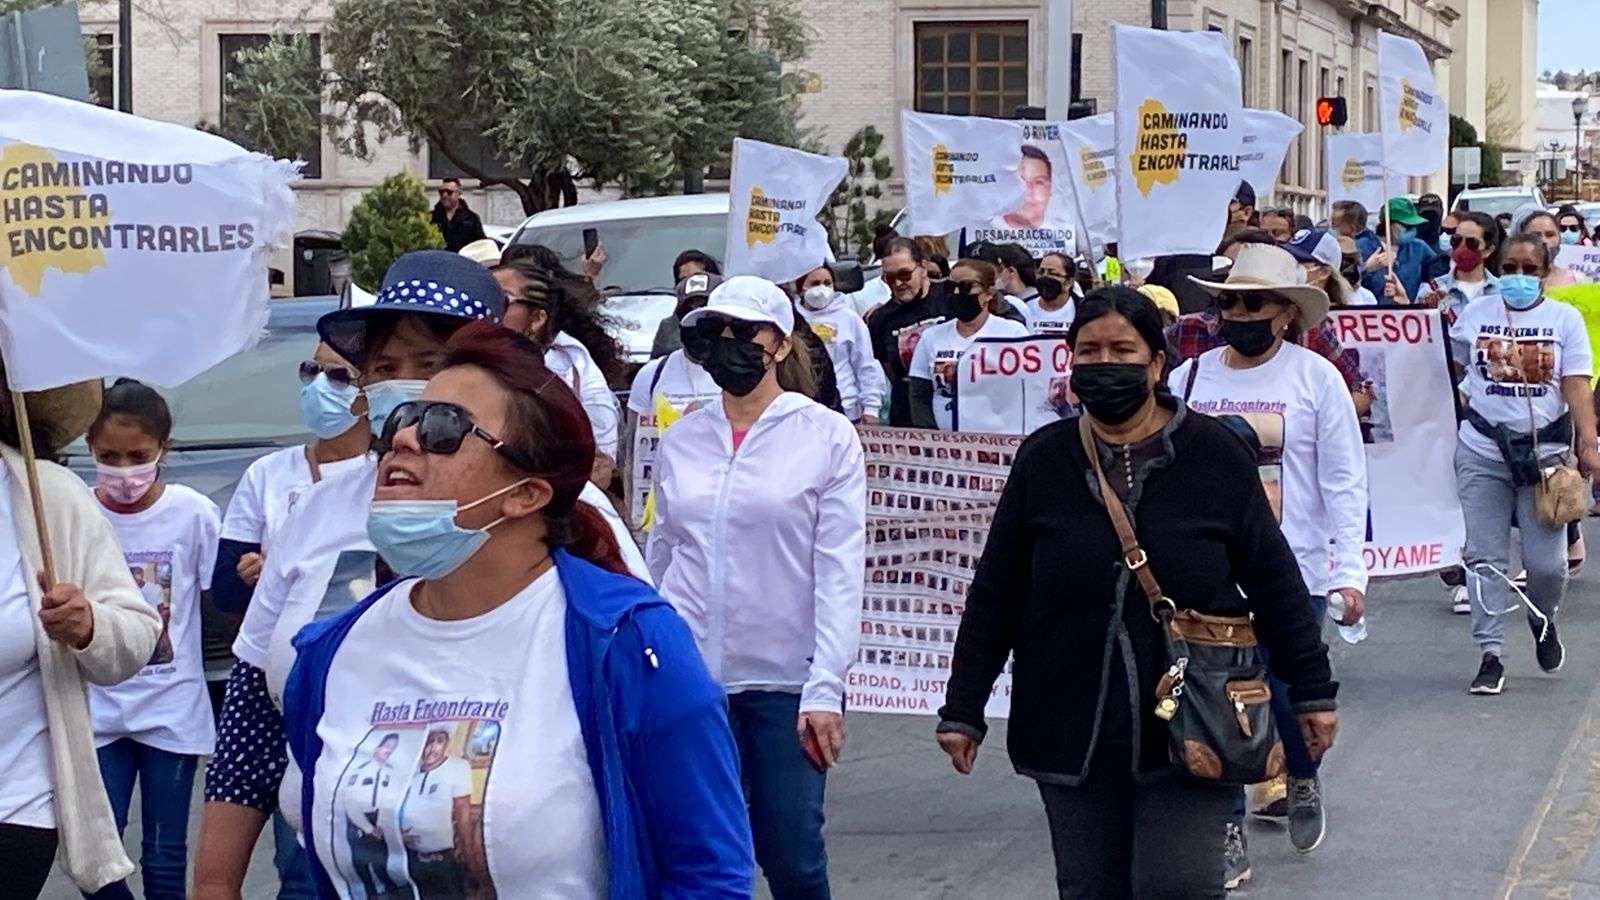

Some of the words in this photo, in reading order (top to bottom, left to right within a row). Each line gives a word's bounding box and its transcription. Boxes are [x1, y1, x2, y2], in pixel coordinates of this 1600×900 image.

[1031, 125, 1060, 140] RIVER
[1143, 112, 1229, 130] CAMINANDO
[1140, 132, 1188, 150] HASTA
[2, 160, 193, 190] CAMINANDO
[1138, 153, 1240, 171] ENCONTRARLE
[4, 193, 109, 223] HASTA
[7, 223, 254, 257] ENCONTRARLES
[1337, 313, 1434, 344] RESO!
[970, 345, 1042, 383] ¡LOS
[1052, 344, 1070, 373] Q
[1363, 543, 1442, 571] OYAME
[849, 673, 907, 692] ERDAD,
[911, 678, 946, 694] JUST
[371, 700, 412, 722] Hasta
[413, 696, 510, 721] Encontrarte
[846, 693, 930, 711] HIHUAHUA
